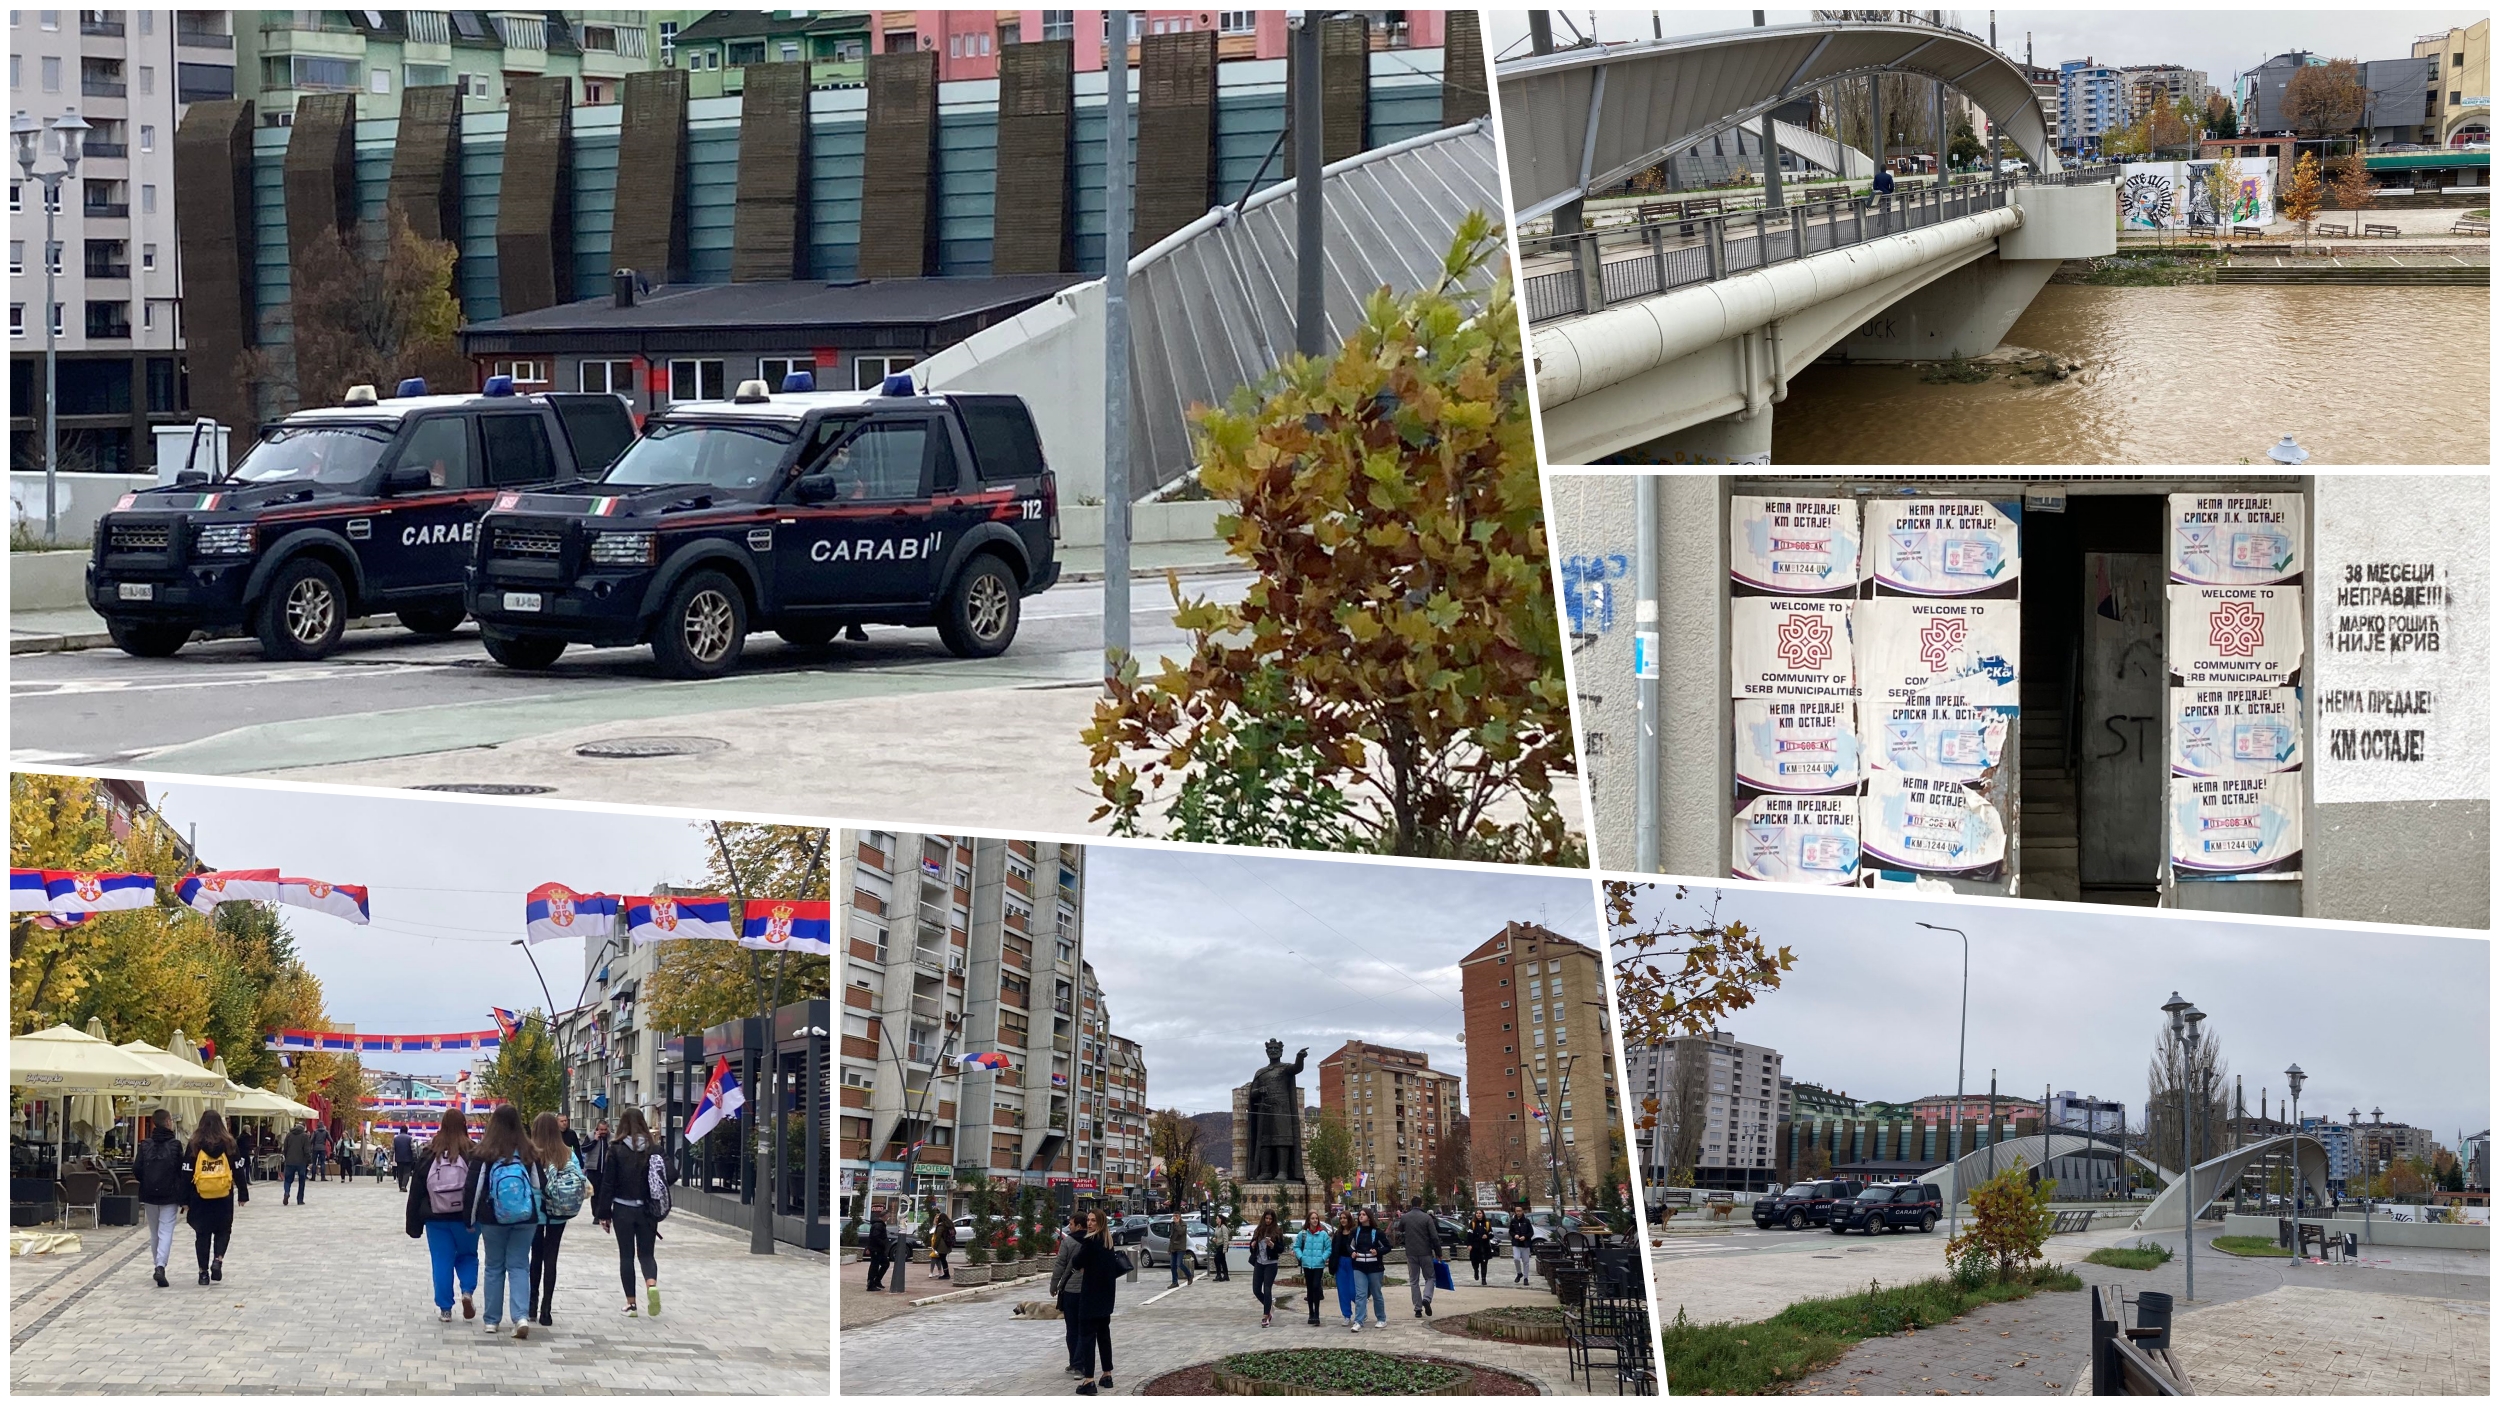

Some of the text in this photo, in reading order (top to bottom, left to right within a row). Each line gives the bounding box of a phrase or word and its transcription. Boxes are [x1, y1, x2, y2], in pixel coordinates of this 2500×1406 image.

[1021, 500, 1042, 520] 112
[1765, 502, 1841, 514] НЕМА ПРЕДАЈЕ!
[1909, 504, 1984, 516] НЕМА ПРЕДАЈЕ!
[2198, 498, 2272, 510] НЕМА ПРЕДАЈЕ!
[1794, 516, 1831, 528] ОСТАЈЕ!
[2184, 512, 2218, 523] СРПСКА
[2248, 512, 2285, 523] ОСТАЈЕ!
[1896, 518, 1930, 530] СРПСКА
[1960, 518, 1996, 530] ОСТАЈЕ!
[2345, 564, 2434, 583] 38 МЕСЕЦИ
[2202, 590, 2256, 598] WELCOME
[2338, 587, 2442, 607] НЕПРАВДЕ!!!
[1770, 602, 1842, 612] WELCOME TO
[1912, 606, 1984, 615] WELCOME TO
[2340, 616, 2439, 632] МАРКО РОШИЋ
[2338, 633, 2439, 652] НИЈЕ КРИВ
[2194, 661, 2278, 670] COMMUNITY OF
[1762, 673, 1846, 684] COMMUNITY OF
[1745, 685, 1862, 696] SERB MUNICIPALITIES
[2198, 689, 2272, 702] НЕМА ПРЕДАЈЕ!
[1770, 703, 1844, 714] НЕМА ПРЕДАЈЕ!
[2185, 705, 2219, 717] СРПСКА
[2248, 703, 2285, 715] ОСТАЈЕ!
[2325, 690, 2431, 718] НЕМА ПРЕДАЈЕ!
[1893, 709, 1926, 720] СРПСКА
[1799, 717, 1835, 728] ОСТАЈЕ!
[2331, 729, 2424, 763] КМ ОСТАЈЕ!
[1903, 777, 1928, 790] НЕМА
[2192, 779, 2267, 793] НЕМА ПРЕДАЈЕ!
[2222, 793, 2259, 805] ОСТАЈЕ!
[1767, 800, 1842, 812] НЕМА ПРЕДАЈЕ!
[1754, 814, 1788, 824] СРПСКА
[1818, 814, 1854, 826] ОСТАЈЕ!
